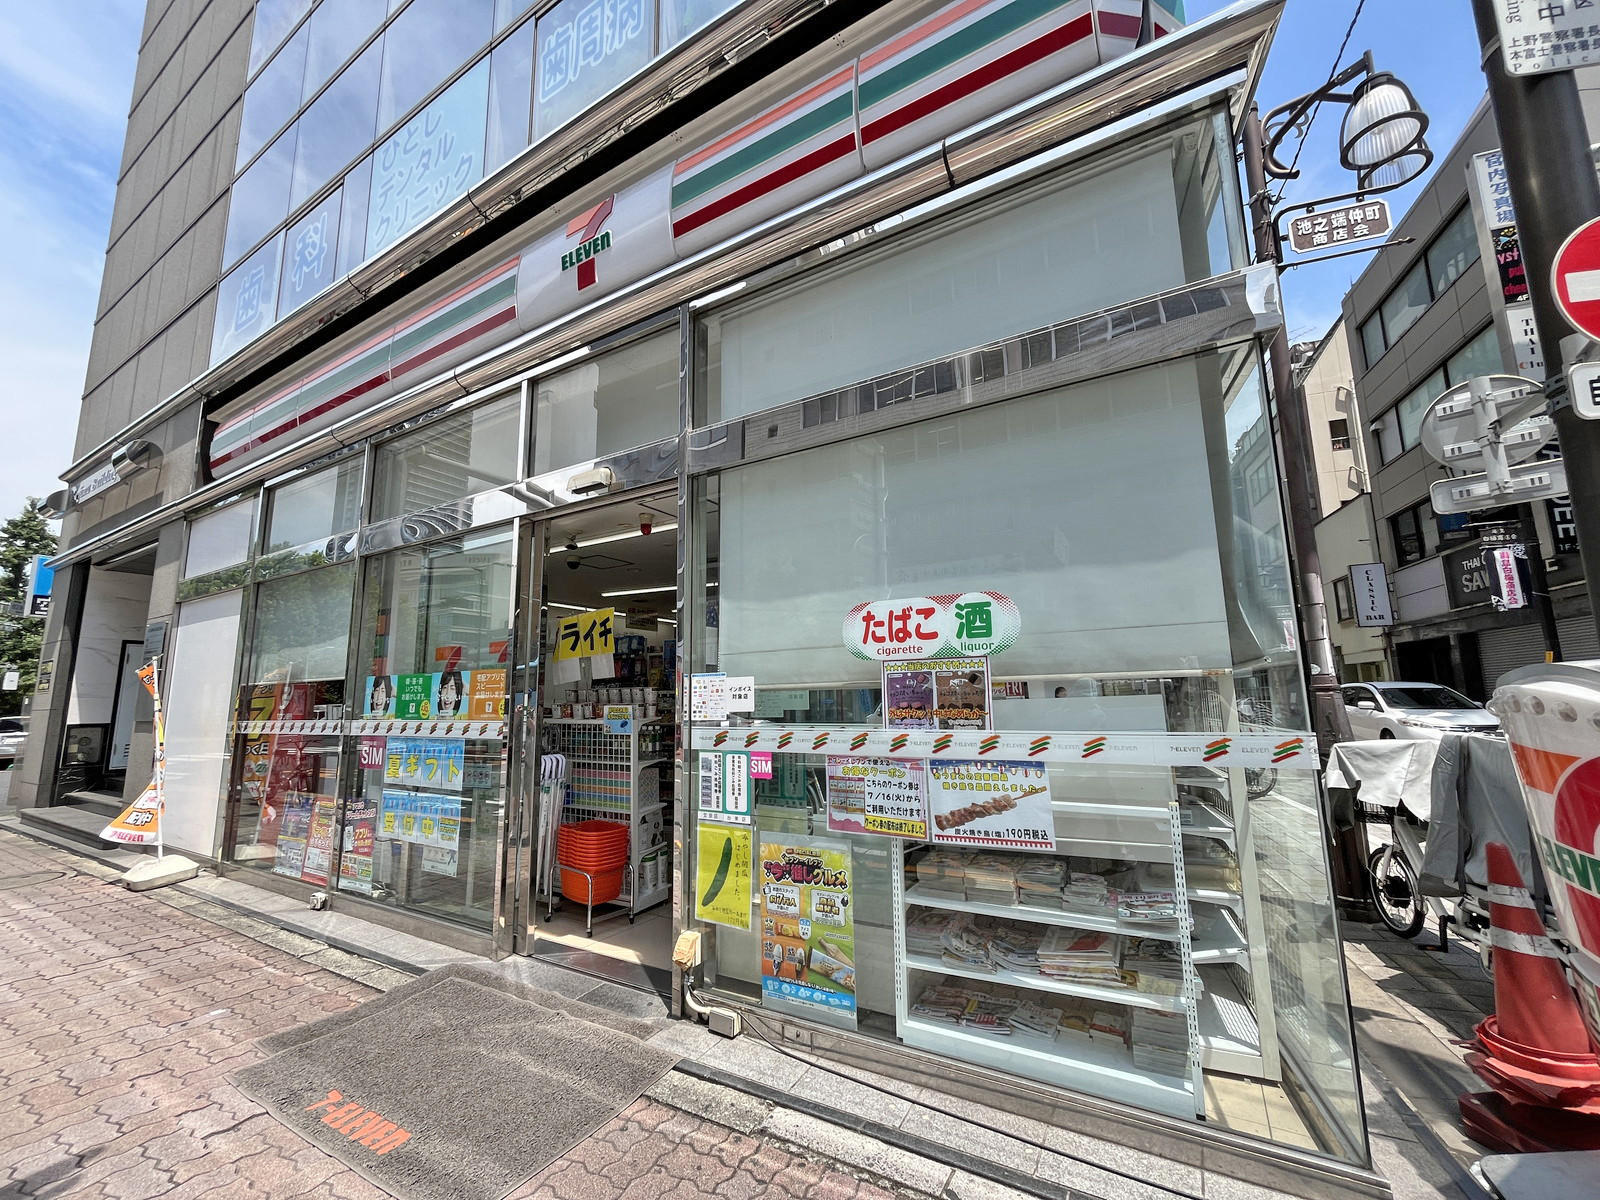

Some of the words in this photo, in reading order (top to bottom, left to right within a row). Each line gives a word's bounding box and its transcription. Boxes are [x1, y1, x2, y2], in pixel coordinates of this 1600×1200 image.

[541, 0, 645, 101] 歯周病
[1513, 55, 1600, 72] Polic
[381, 107, 442, 170] ひとし
[376, 132, 455, 211] デンタル
[374, 155, 475, 243] クリニック
[1296, 205, 1381, 236] 池之端仲町
[1312, 224, 1370, 246] 商店会
[1517, 294, 1529, 302] 4F
[1365, 569, 1377, 612] CLASSIC
[561, 616, 613, 653] ライチ
[862, 605, 939, 645] たばこ
[955, 601, 993, 640] 酒
[876, 645, 923, 657] cigarette
[960, 641, 995, 653] liquor
[361, 746, 383, 766] SIM
[386, 753, 460, 783] 夏ギフト
[751, 760, 772, 774] SIM
[842, 766, 906, 778] お得なクーポン
[866, 779, 920, 791] こちらのクーポン券は
[934, 772, 1008, 781] おつまみの定番商品
[383, 812, 435, 839] 受付中
